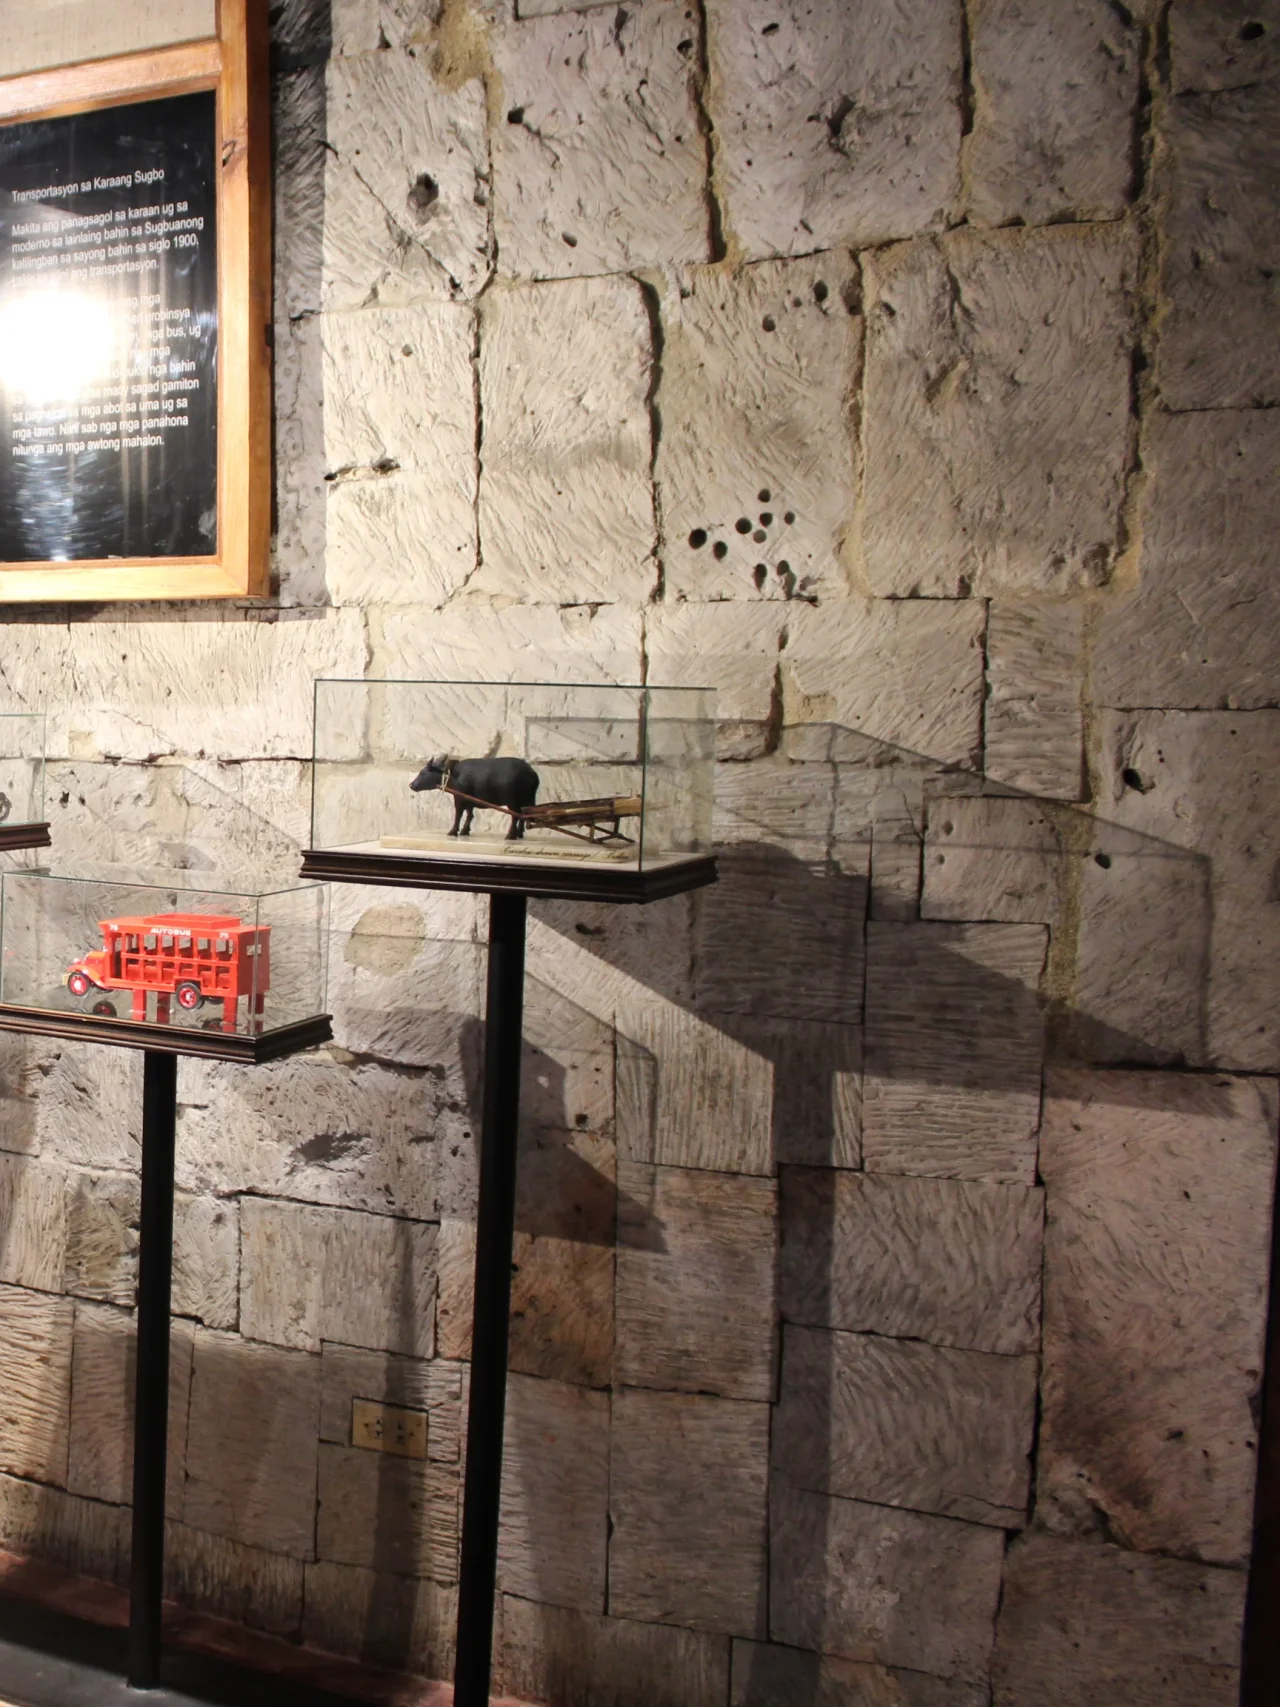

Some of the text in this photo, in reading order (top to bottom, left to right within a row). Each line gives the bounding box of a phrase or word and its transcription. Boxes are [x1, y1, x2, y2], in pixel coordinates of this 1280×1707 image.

[12, 169, 164, 202] Transportasyon sa Karaang Sugbo
[12, 201, 188, 236] Makita ang panagsagol sa karaan ug sa
[12, 217, 204, 252] moderno sa lainlaing bahin sa Sugbuanong
[12, 254, 58, 270] katilingban
[60, 253, 71, 263] sa
[74, 248, 105, 262] sayong
[108, 243, 132, 257] bahin
[136, 242, 146, 253] sa
[149, 237, 170, 252] siglo
[90, 259, 159, 276] transportasyon.
[141, 294, 160, 306] mga
[144, 308, 190, 324] robinsya
[167, 325, 186, 337] bus,
[189, 325, 201, 337] ug
[151, 346, 170, 358] mga
[150, 364, 167, 376] nga
[170, 360, 196, 372] bahin
[131, 380, 159, 395] sagad
[162, 378, 199, 394] gamiton
[13, 412, 23, 422] sa
[81, 405, 100, 418] mga
[126, 402, 136, 412] sa
[139, 400, 159, 411] uma
[162, 399, 174, 412] ug
[176, 398, 188, 408] sa
[12, 429, 31, 441] mga
[82, 421, 97, 434] sab
[100, 421, 117, 434] nga
[120, 419, 139, 432] mga
[142, 415, 188, 431] panahona
[13, 434, 164, 456] nitunga ang mga awtong mahalon.
[150, 928, 191, 936] AUTOBUS
